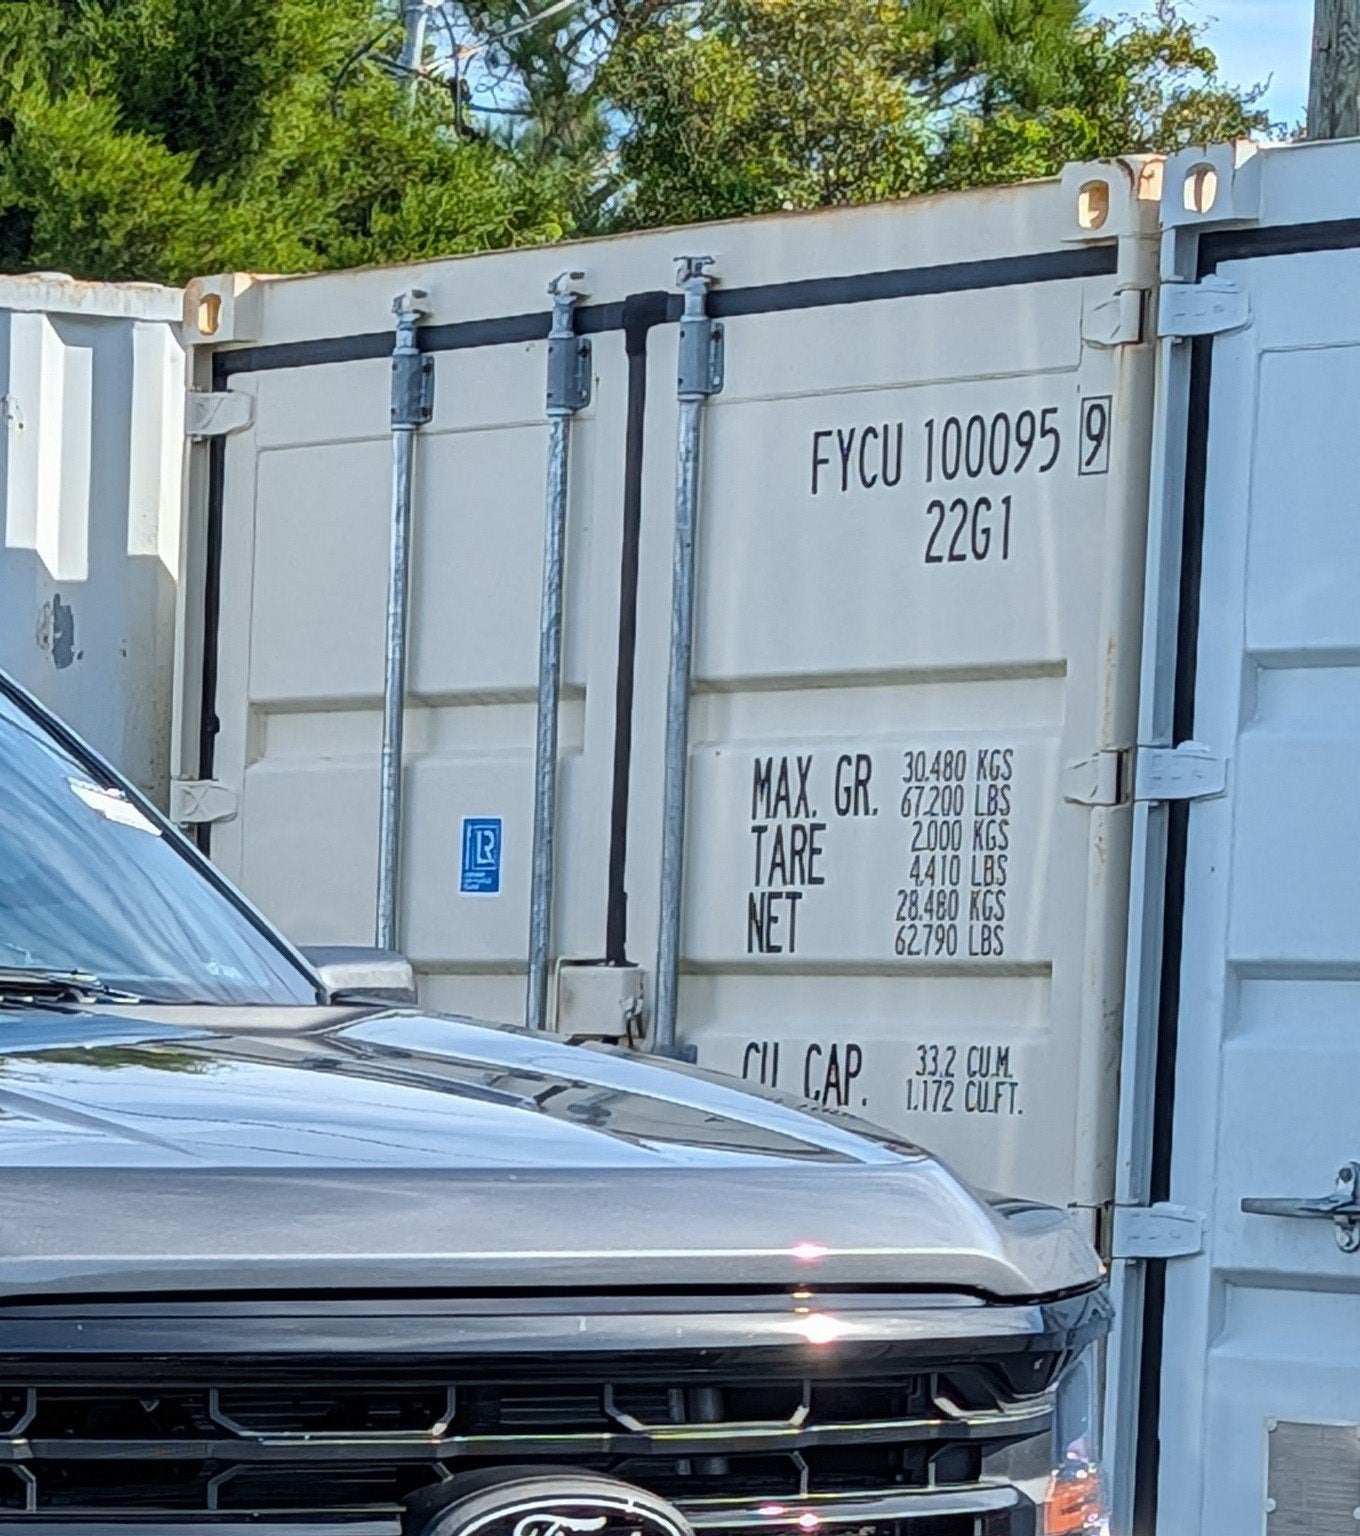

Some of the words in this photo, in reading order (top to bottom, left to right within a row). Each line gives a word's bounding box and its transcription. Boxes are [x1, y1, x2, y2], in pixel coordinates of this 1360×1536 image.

[811, 422, 904, 495] FYCU
[924, 407, 1061, 484] 100095
[1084, 402, 1107, 468] 9
[924, 495, 1013, 564] 22G1
[902, 749, 967, 783] 30.480
[976, 748, 1014, 782] KGS
[752, 755, 818, 820] MAX.
[835, 754, 878, 816] GR.
[975, 784, 1011, 816] LBS
[972, 819, 1010, 852] KGS
[751, 823, 826, 887] TARE
[971, 854, 1008, 887] LBS
[747, 891, 803, 953] NET
[969, 889, 1006, 921] KGS
[968, 924, 1004, 956] LBS
[804, 1043, 868, 1106] CAP.
[915, 1044, 957, 1078] 33.2
[906, 1078, 955, 1112] 1.172
